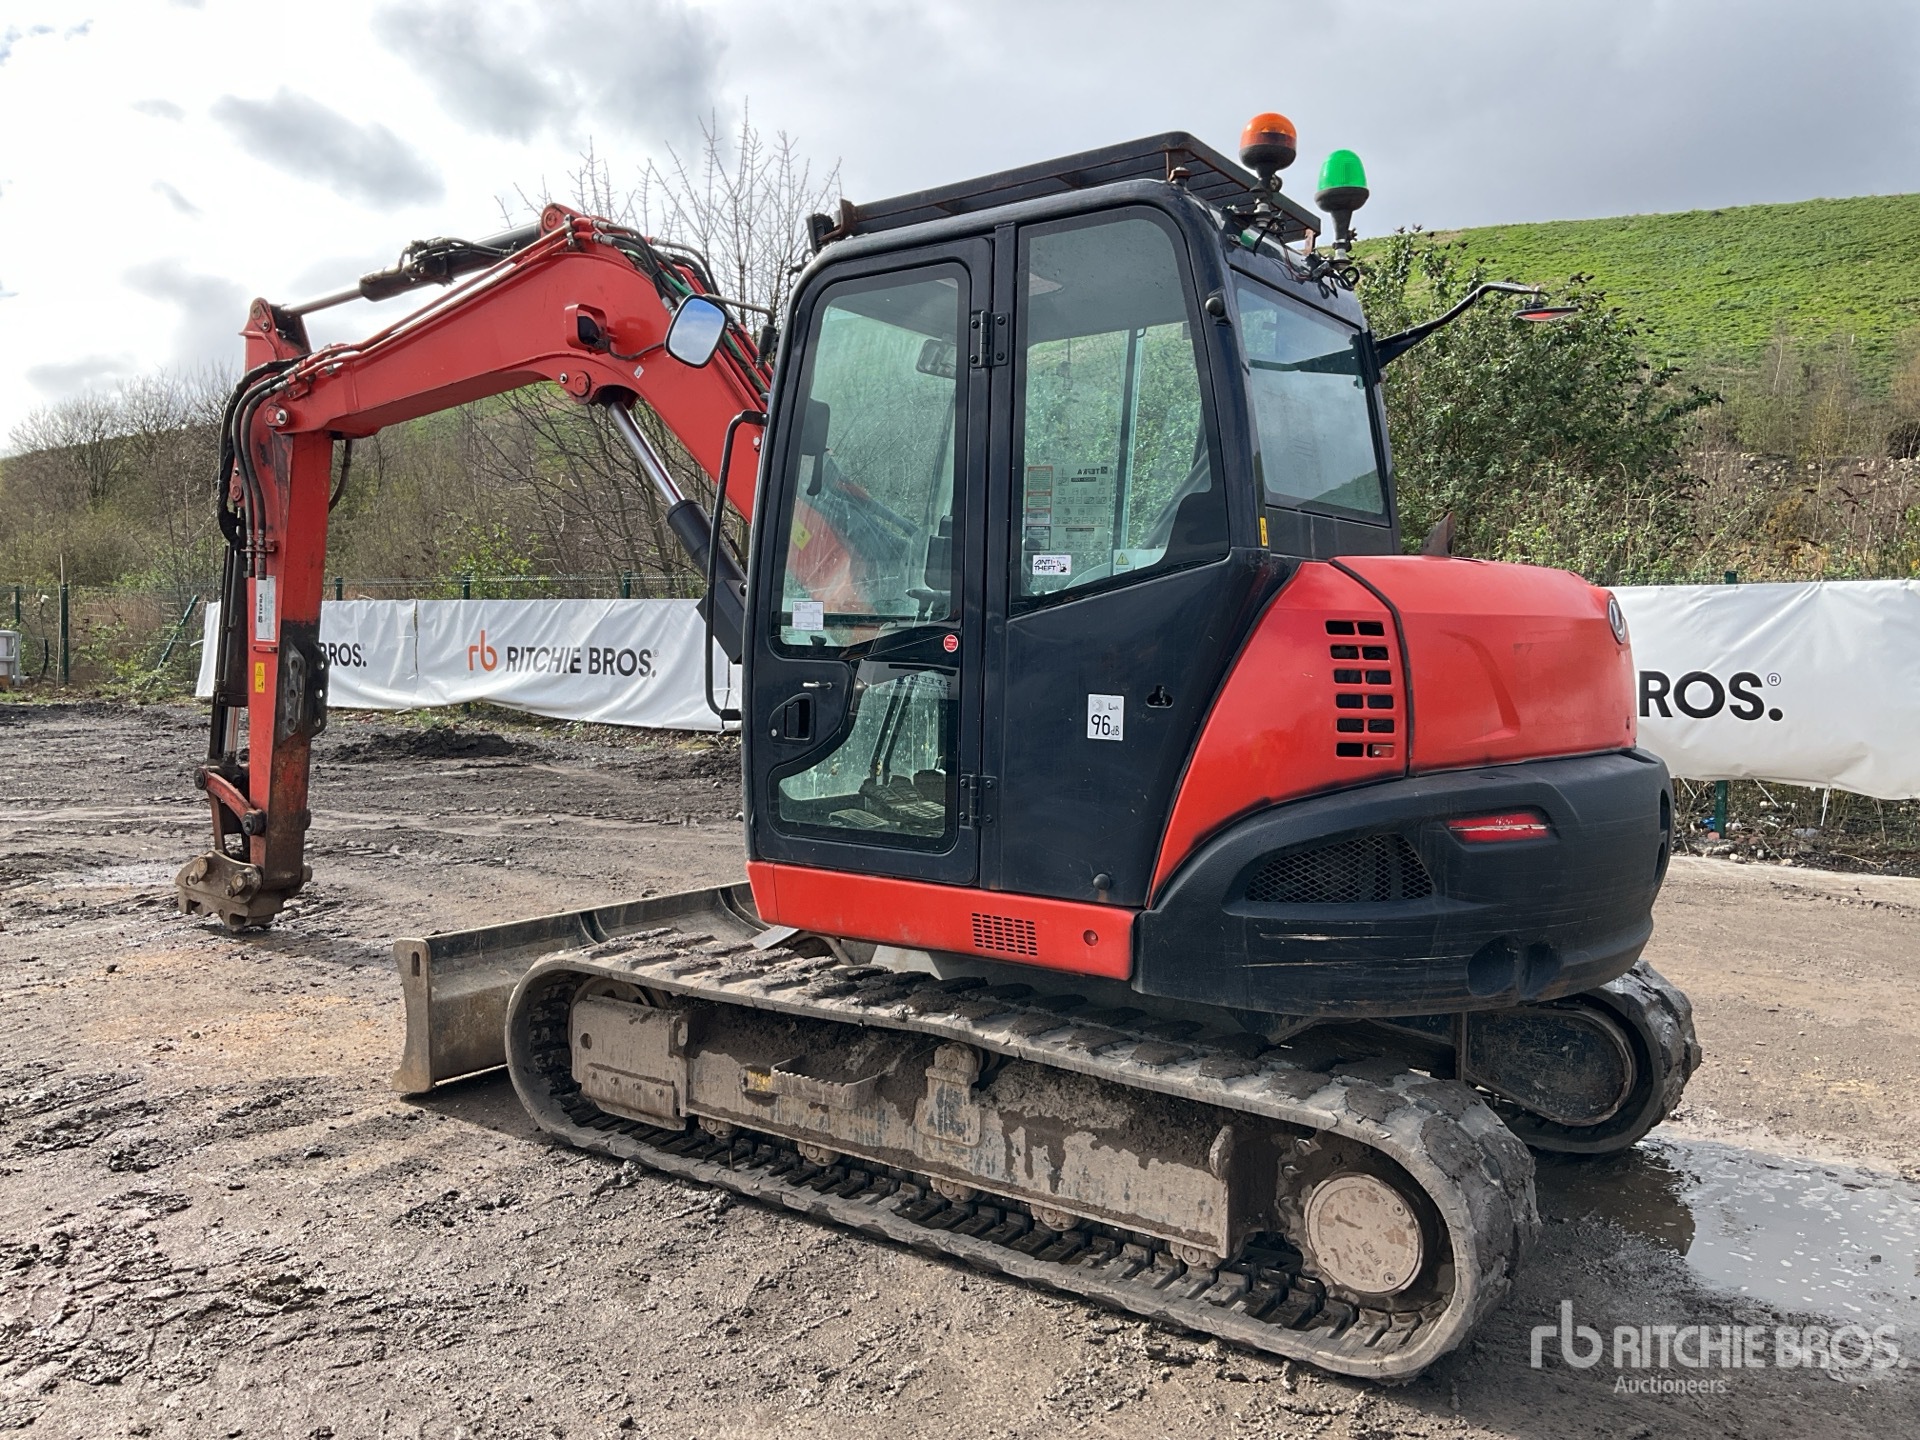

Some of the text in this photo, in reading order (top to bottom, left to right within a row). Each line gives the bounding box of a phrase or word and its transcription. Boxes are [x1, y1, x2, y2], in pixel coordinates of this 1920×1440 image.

[505, 646, 582, 674] RITCHIE
[1091, 713, 1120, 736] 96 dB
